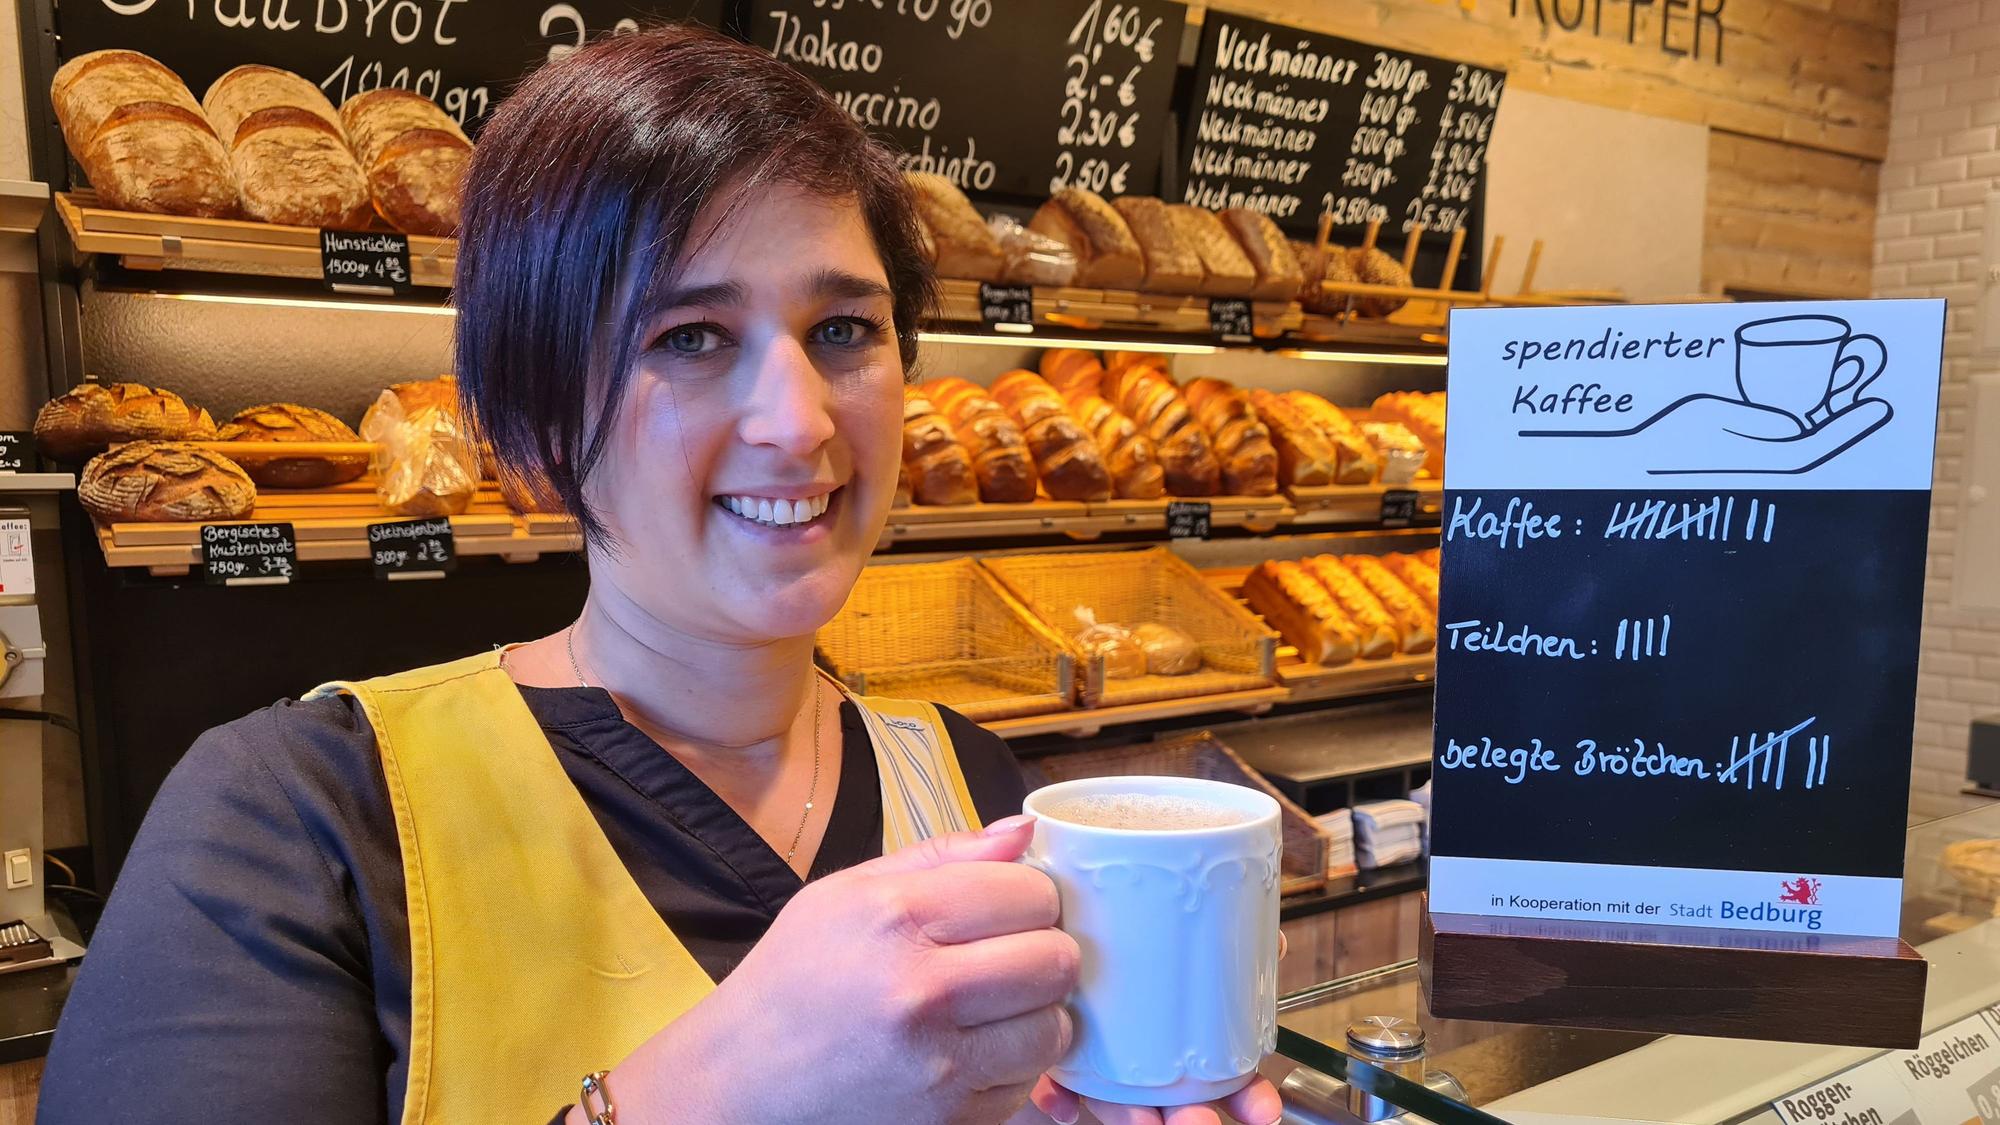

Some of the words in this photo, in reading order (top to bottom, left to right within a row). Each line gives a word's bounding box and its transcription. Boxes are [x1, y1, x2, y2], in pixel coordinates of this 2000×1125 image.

[769, 10, 883, 73] Kakao
[1502, 327, 1726, 369] spendierter
[1511, 383, 1634, 416] Kaffee
[203, 524, 281, 544] Bergisches
[1490, 893, 1505, 907] in
[1509, 894, 1602, 913] Kooperation
[1606, 900, 1631, 915] mit
[1634, 902, 1661, 917] der
[1669, 903, 1713, 919] Stadt
[1720, 901, 1824, 930] Bedburg
[1903, 1032, 1990, 1081] Röggelchen
[1781, 1081, 1853, 1123] Roggen-
